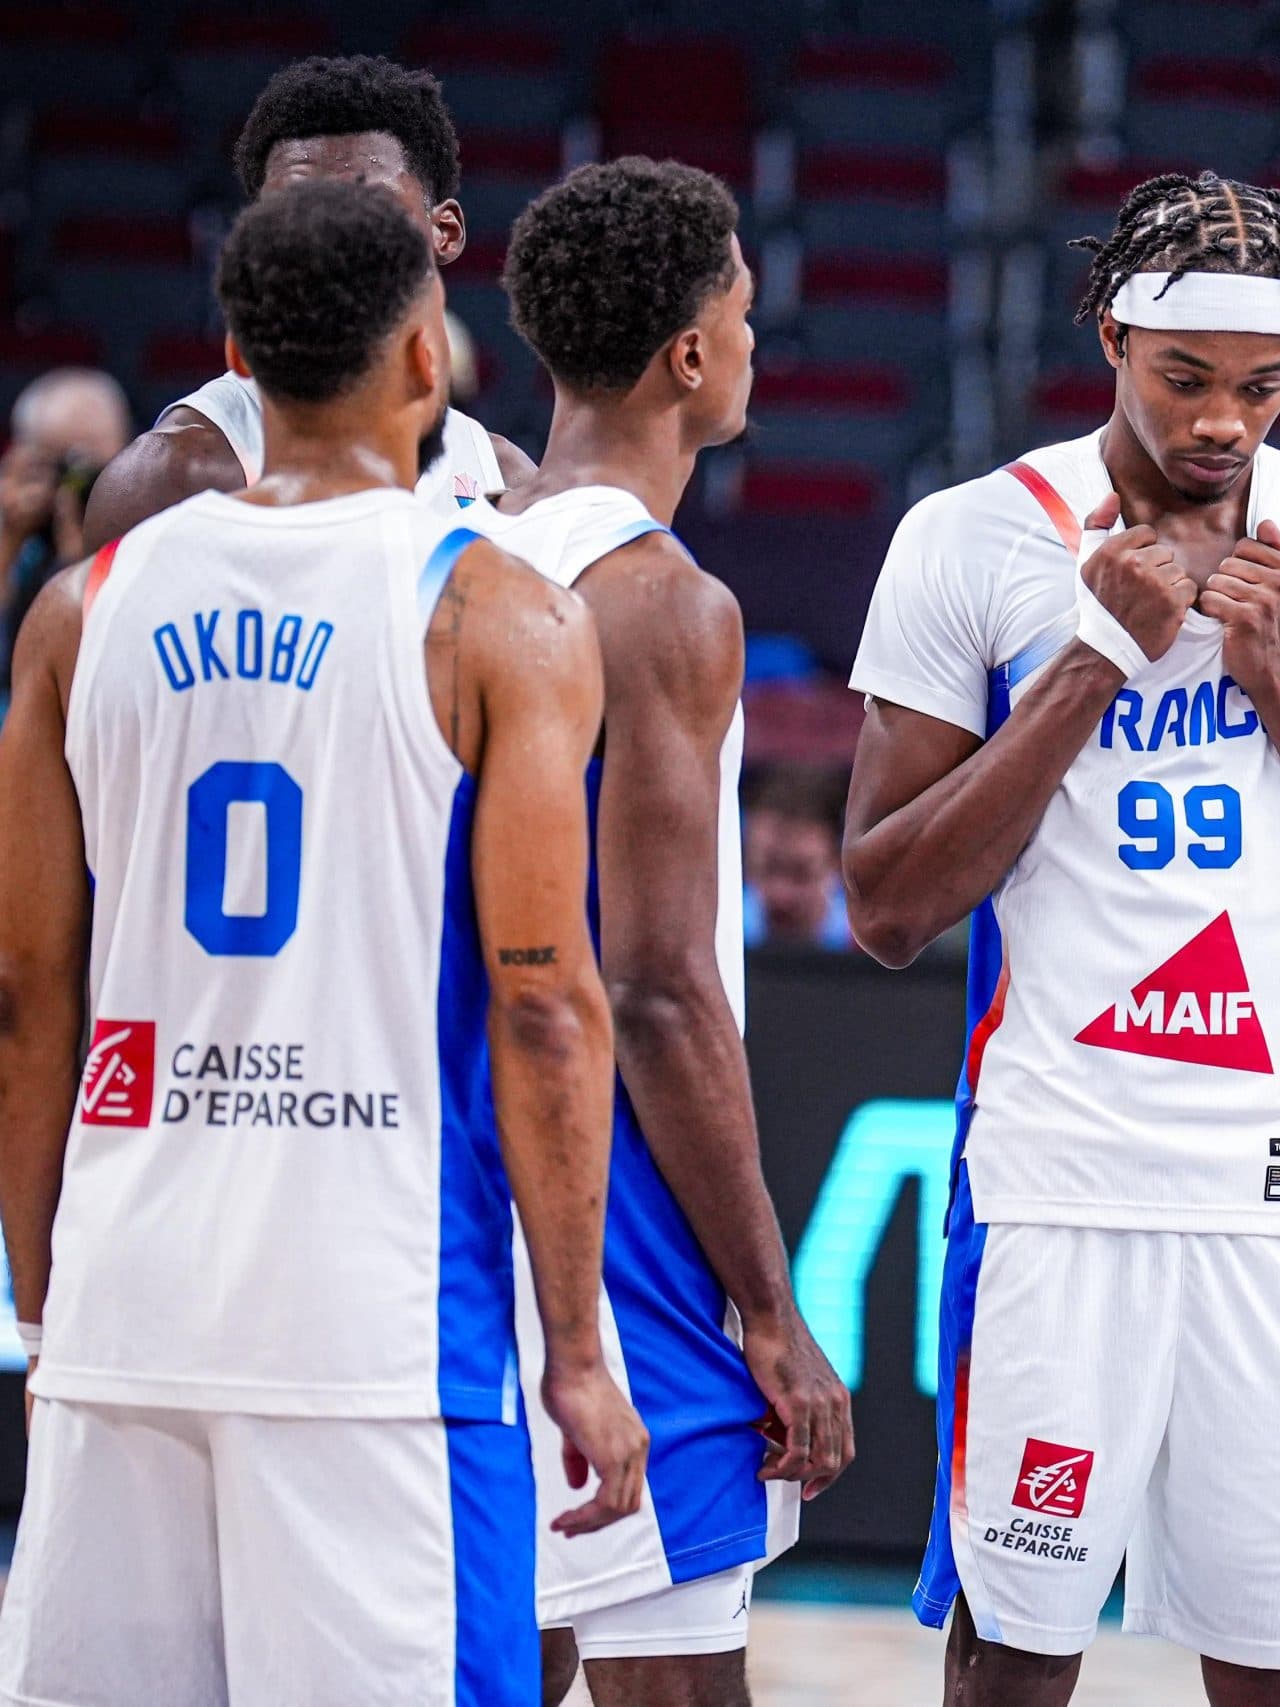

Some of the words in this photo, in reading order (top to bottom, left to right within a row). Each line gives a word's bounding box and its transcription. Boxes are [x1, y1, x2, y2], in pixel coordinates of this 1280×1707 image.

[152, 608, 335, 693] OKOBO
[1117, 780, 1242, 870] 99
[184, 760, 304, 958] 0
[1114, 990, 1254, 1035] MAIF
[172, 1044, 303, 1080] CAISSE
[1010, 1518, 1073, 1542] CAISSE
